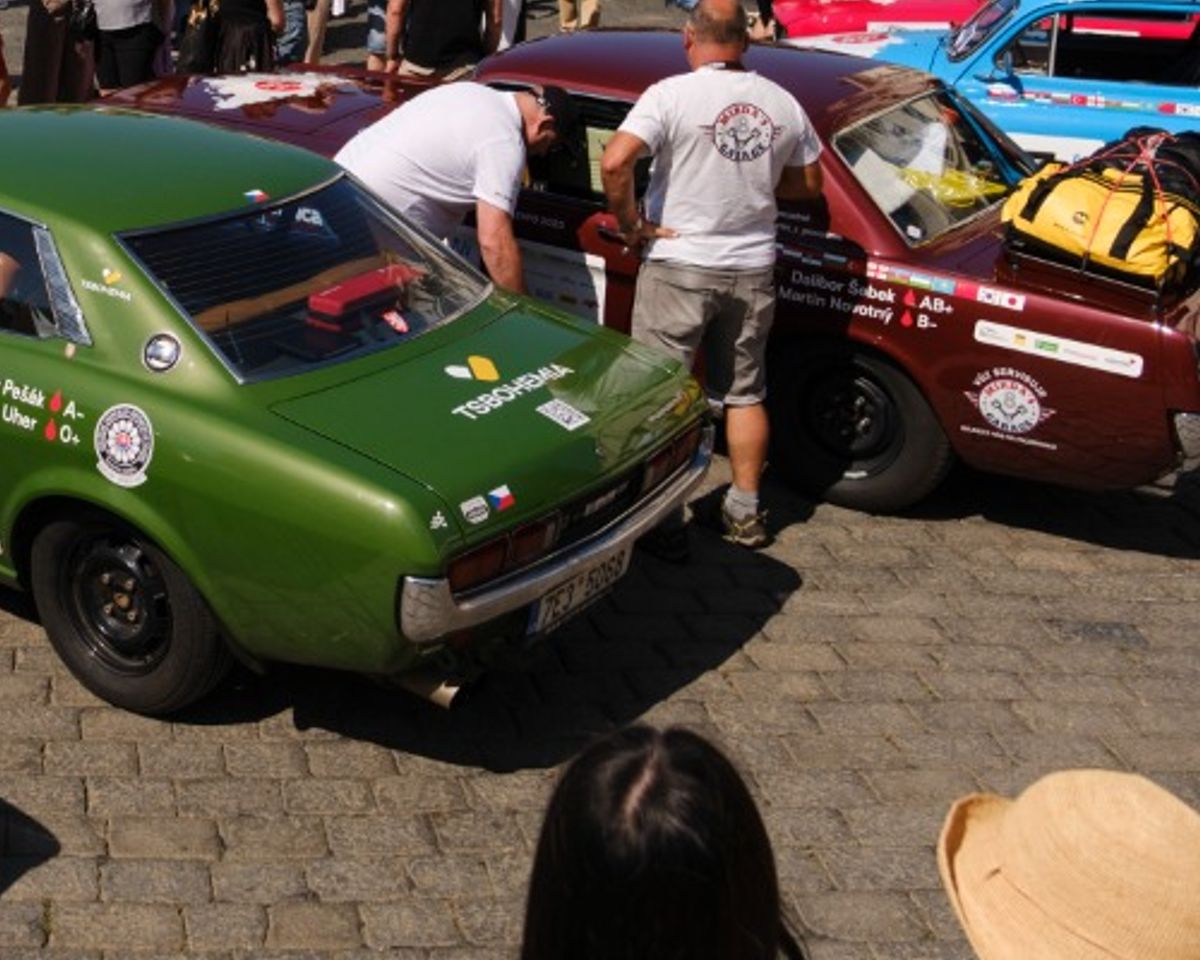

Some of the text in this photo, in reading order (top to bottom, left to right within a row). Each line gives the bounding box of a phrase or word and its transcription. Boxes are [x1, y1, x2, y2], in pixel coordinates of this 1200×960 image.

[778, 285, 895, 325] Martin Novotný
[919, 295, 954, 314] AB+
[2, 403, 38, 431] Uher
[62, 400, 85, 420] A-
